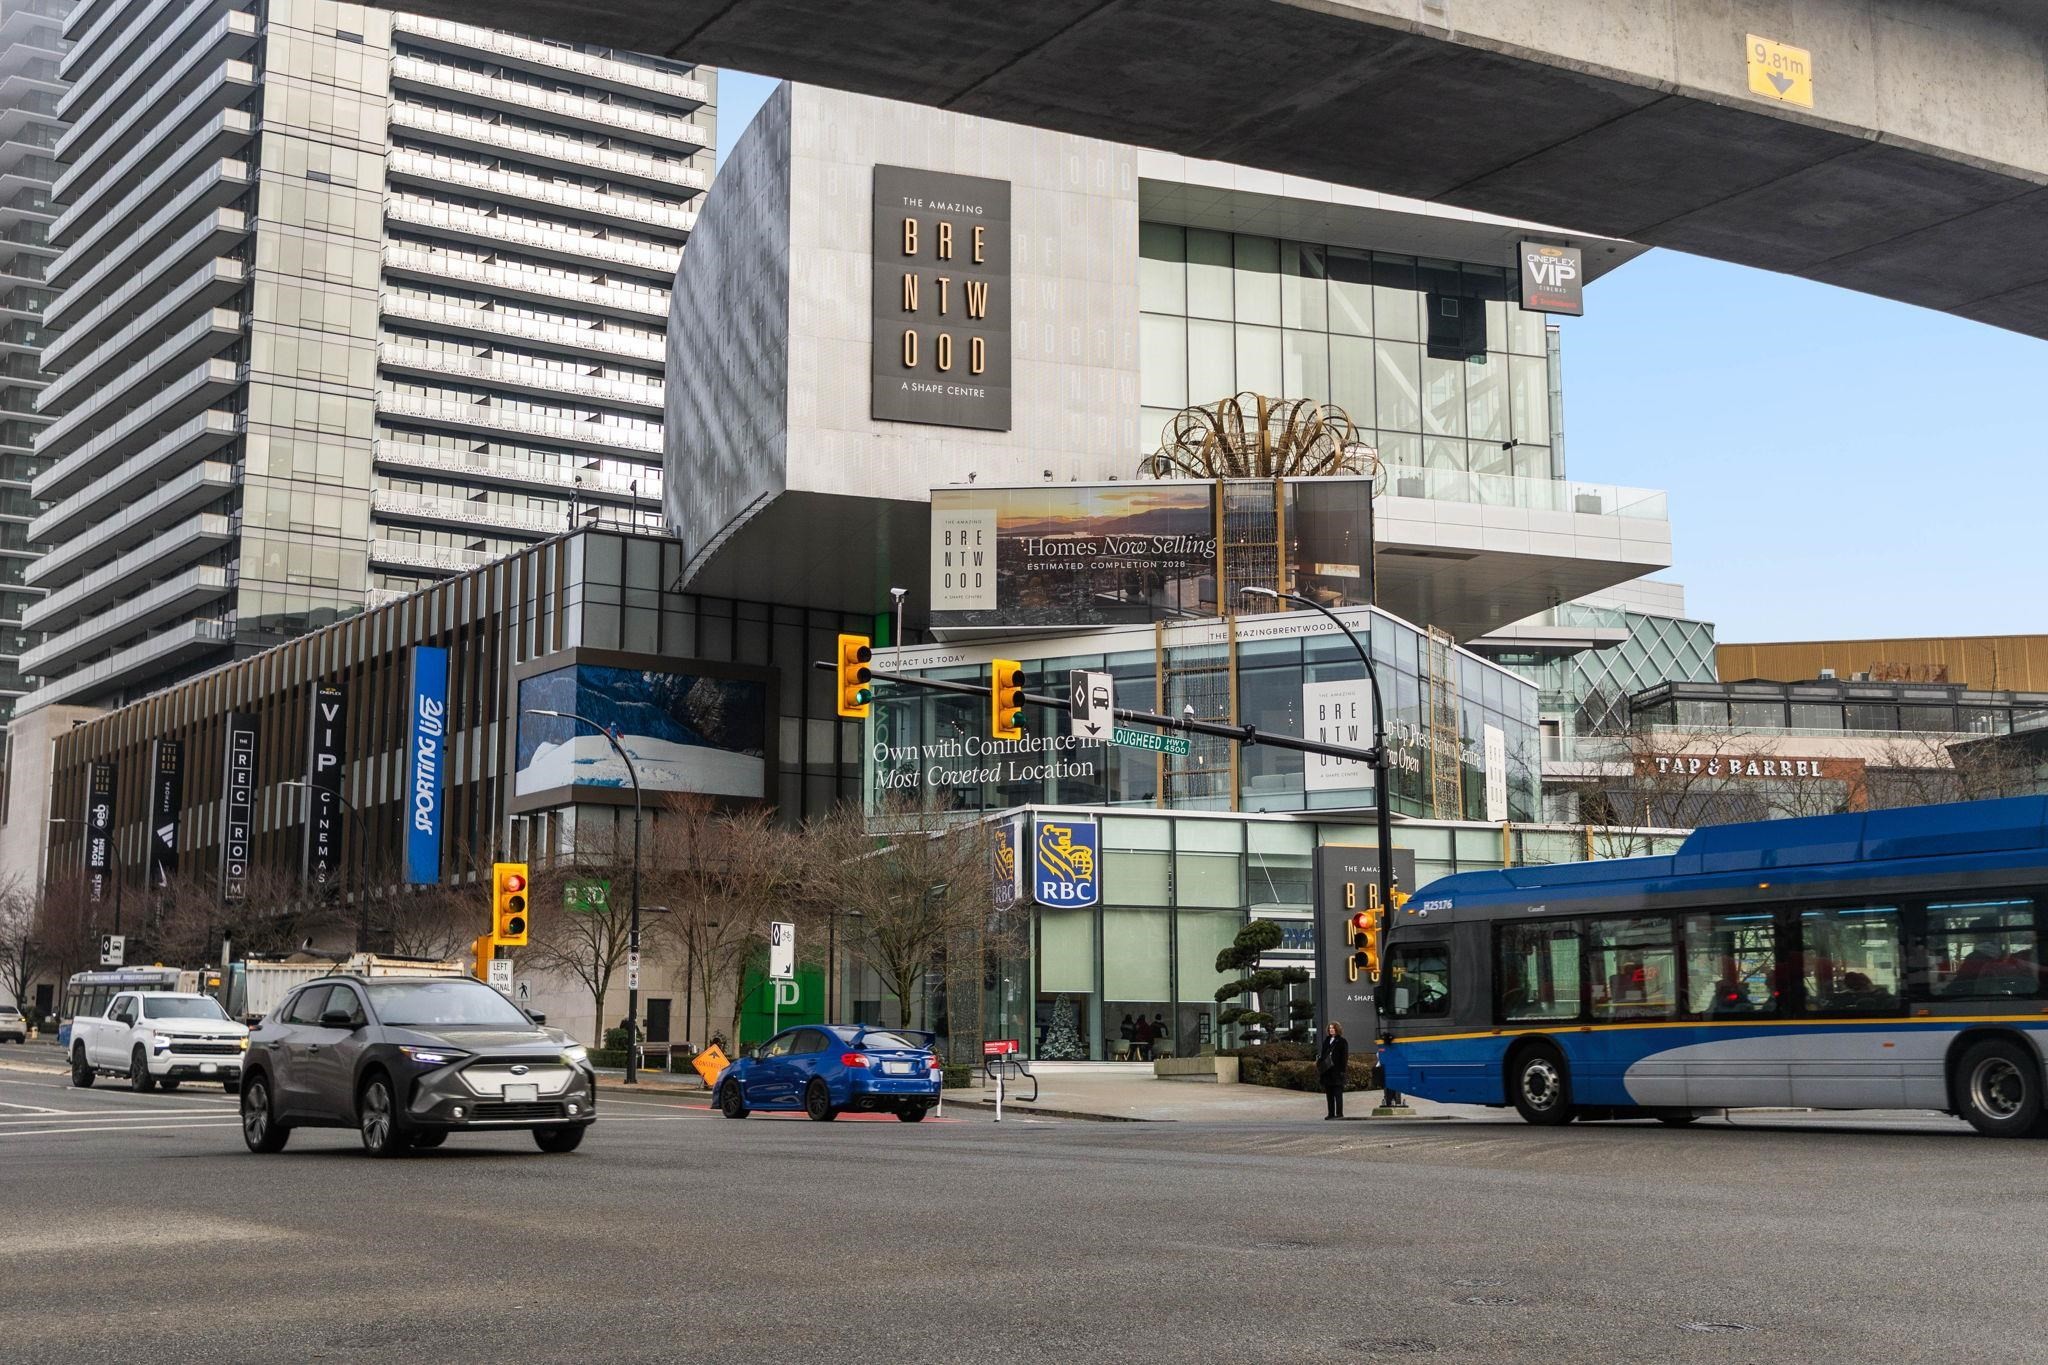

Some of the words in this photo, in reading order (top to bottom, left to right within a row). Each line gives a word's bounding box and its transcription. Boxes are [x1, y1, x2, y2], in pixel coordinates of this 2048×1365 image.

[1755, 43, 1804, 75] 9.81m
[903, 197, 923, 207] THE
[929, 200, 983, 215] AMAZING
[1527, 254, 1576, 267] CINEPLEX
[1528, 261, 1576, 287] VIP
[1539, 285, 1567, 294] CINEMAS
[902, 382, 909, 391] A
[911, 383, 943, 394] SHAPE
[947, 386, 985, 398] CENTRE
[1027, 538, 1097, 556] Homes
[1102, 536, 1147, 555] Now
[1151, 535, 1217, 558] Selling
[1027, 562, 1084, 571] ESTIMATED
[1090, 561, 1157, 570] COMPLETION
[1162, 560, 1186, 568] 2028
[879, 658, 919, 668] CONTACT
[922, 657, 934, 665] US
[937, 654, 966, 663] TODAY
[317, 703, 340, 772] VIP
[1166, 738, 1185, 747] HWY
[873, 742, 919, 763] Own
[922, 736, 963, 758] with
[1164, 745, 1186, 754] 4500
[1399, 747, 1420, 775] Open
[1655, 757, 1701, 774] TAP
[1707, 758, 1721, 776] &
[1728, 759, 1823, 777] BARREL
[236, 754, 247, 801] REC
[874, 769, 920, 790] Most
[927, 762, 1001, 786] Coveted
[1008, 758, 1094, 781] Location
[318, 792, 330, 883] CINEMAS
[91, 845, 99, 867] BOW
[97, 838, 106, 867] STERN
[231, 827, 243, 893] ROOM
[995, 884, 1013, 903] RBC
[1042, 881, 1091, 900] RBC
[1423, 899, 1453, 911] H25176
[493, 962, 508, 971] LEFT
[493, 973, 508, 981] TURN
